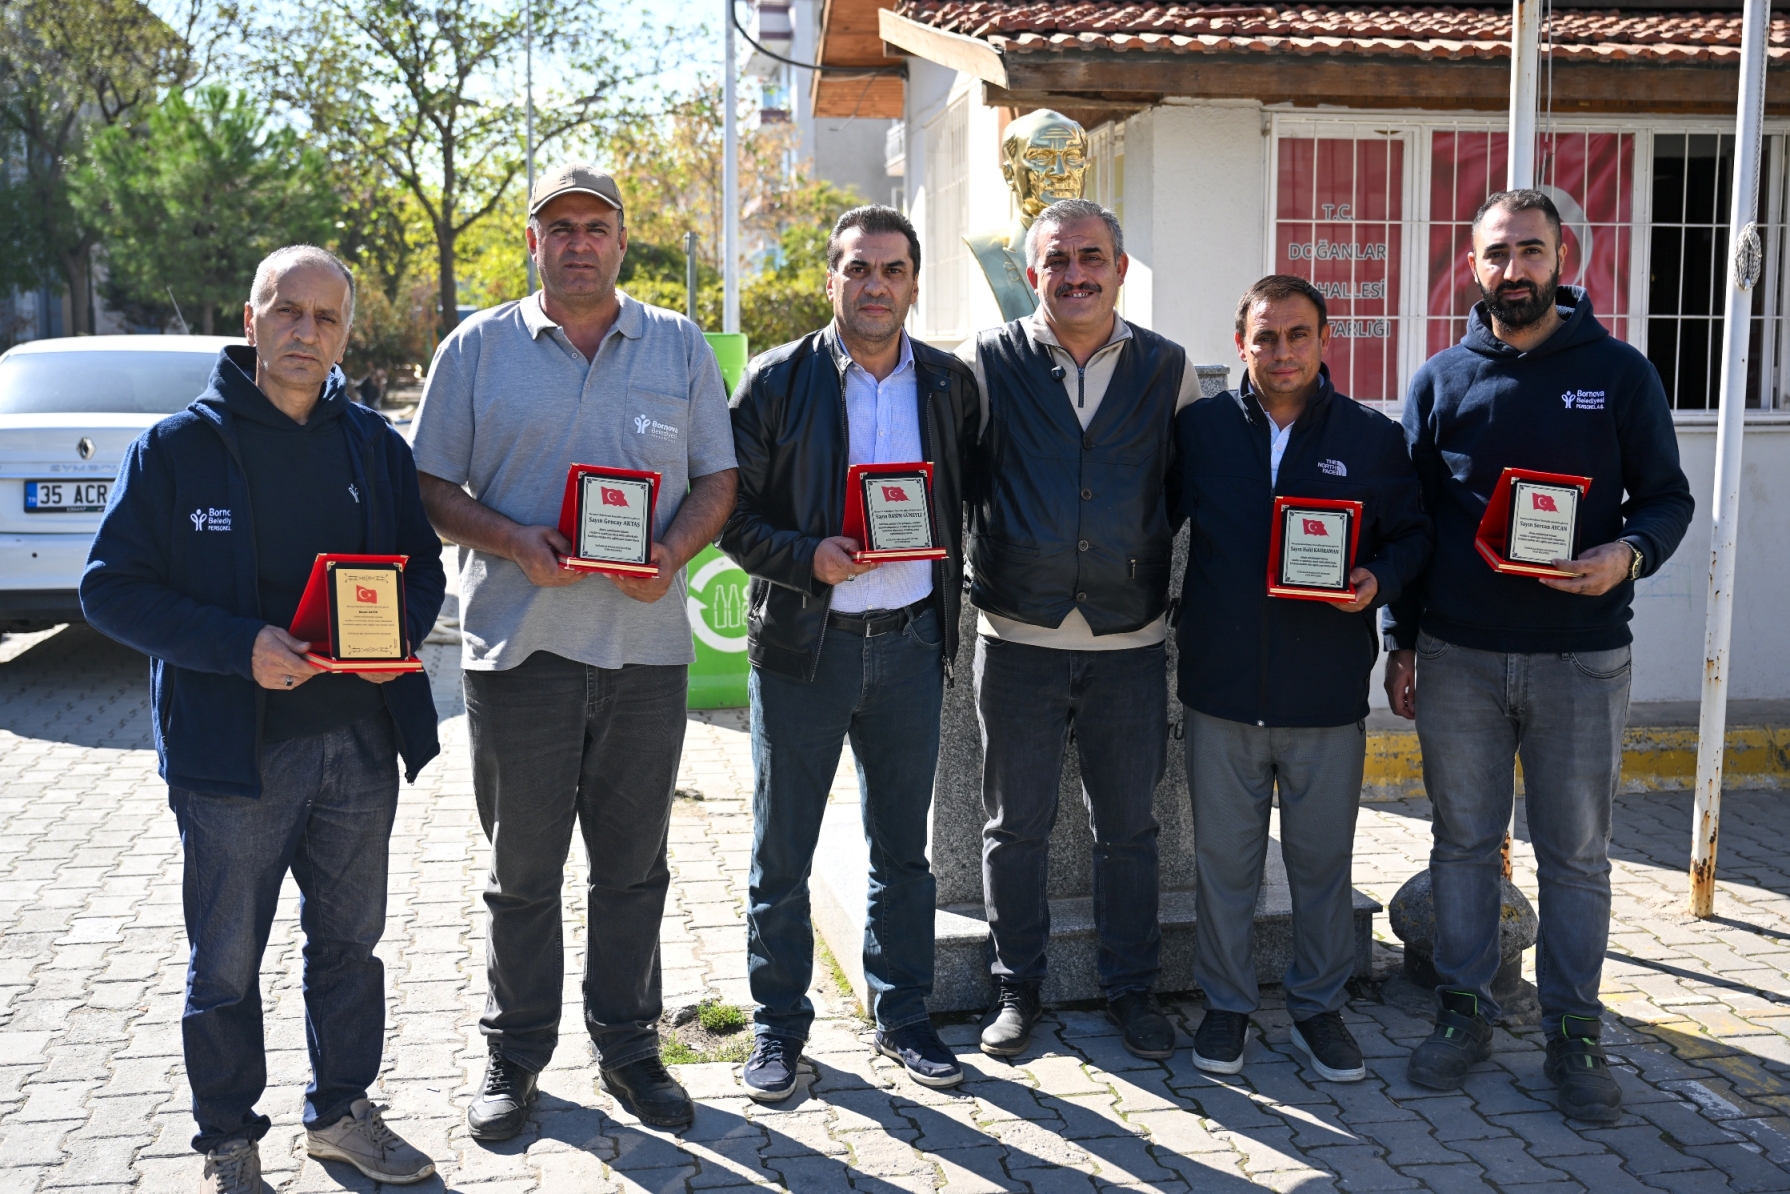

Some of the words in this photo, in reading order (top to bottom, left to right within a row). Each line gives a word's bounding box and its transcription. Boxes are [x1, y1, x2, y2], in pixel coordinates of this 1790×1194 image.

[1323, 204, 1354, 220] T.C.
[1289, 240, 1387, 259] DOĞANLAR
[1318, 278, 1386, 298] HALLESİ
[1328, 318, 1390, 337] TARLIĞI
[652, 421, 678, 433] Bornova
[1317, 462, 1337, 470] NORTH
[40, 485, 62, 504] 35
[74, 485, 107, 504] ACR
[208, 517, 231, 525] Belediy
